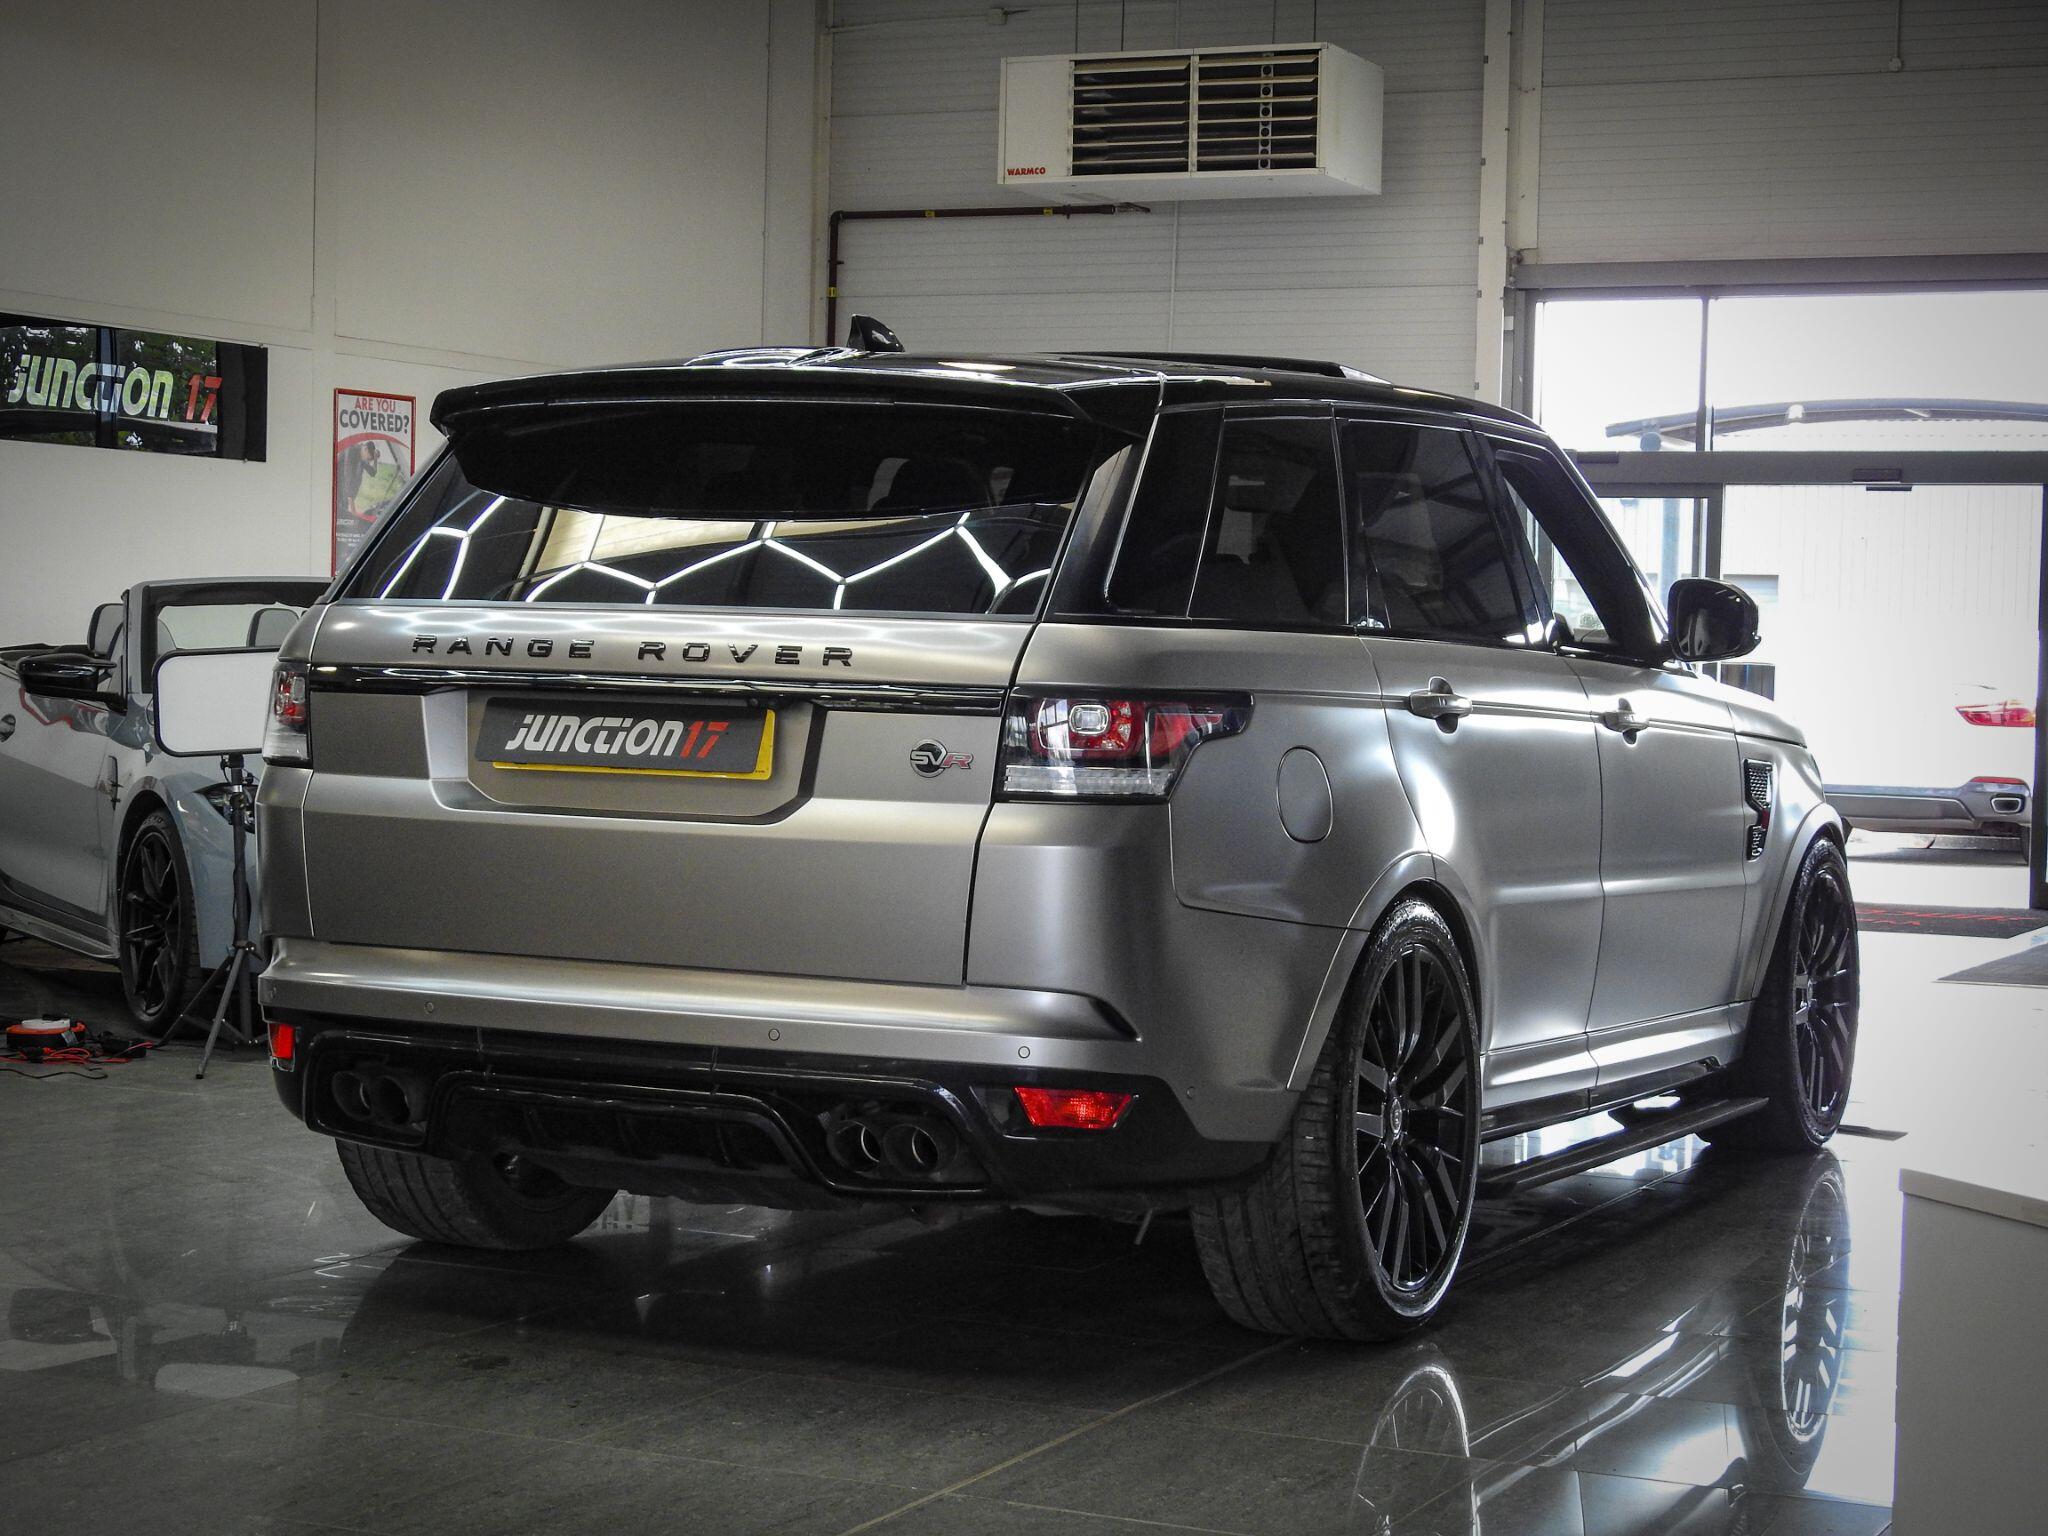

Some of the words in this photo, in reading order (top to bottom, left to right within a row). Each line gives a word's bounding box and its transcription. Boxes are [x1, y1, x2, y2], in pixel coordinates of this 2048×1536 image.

[1007, 167, 1046, 176] WARMCO
[185, 374, 223, 422] 17
[355, 397, 373, 411] ARE
[376, 398, 396, 413] YOU
[340, 409, 410, 434] COVERED?
[412, 634, 595, 659] RANGE
[637, 640, 854, 668] ROVER
